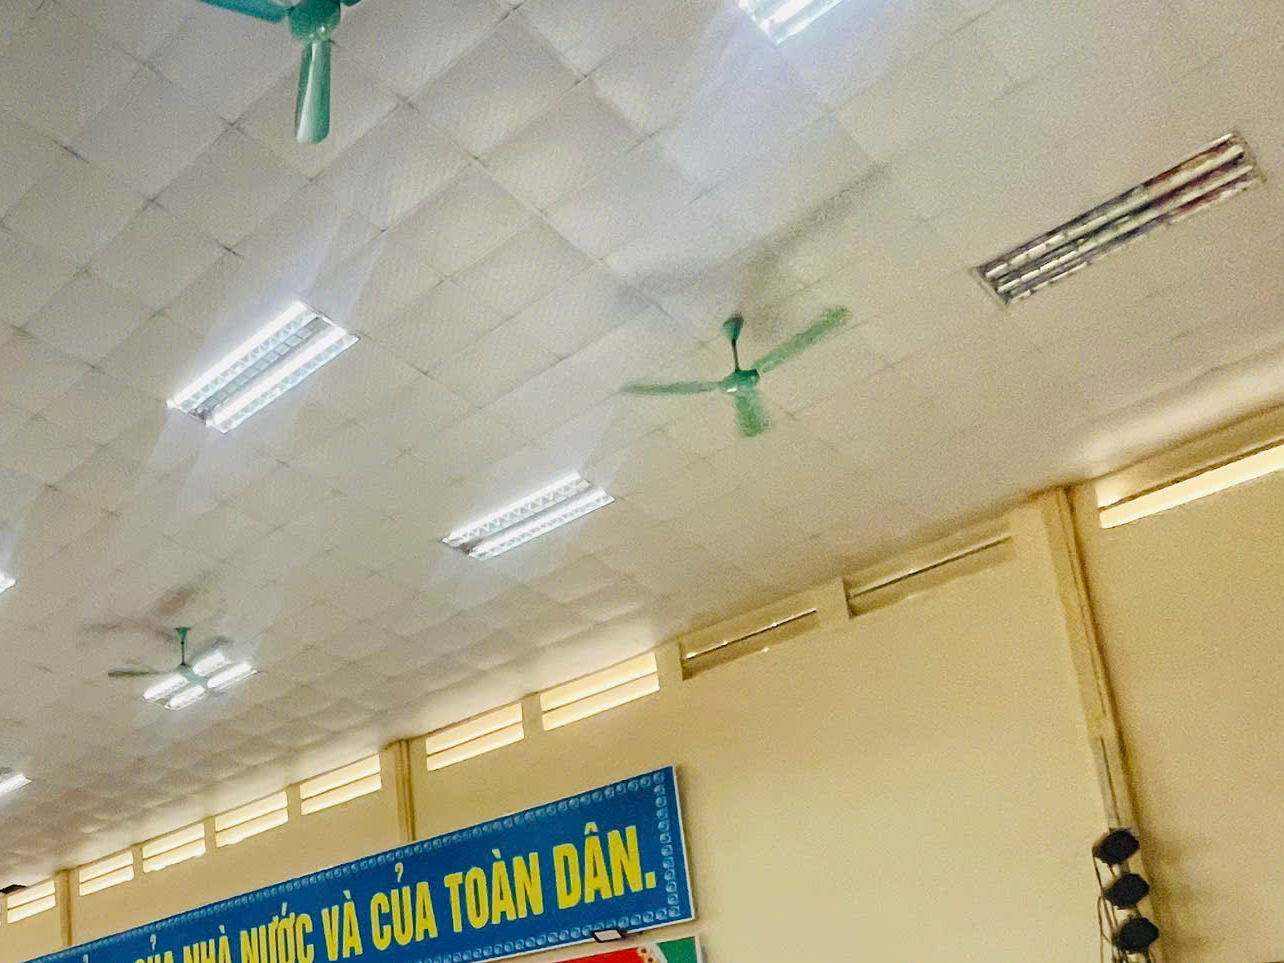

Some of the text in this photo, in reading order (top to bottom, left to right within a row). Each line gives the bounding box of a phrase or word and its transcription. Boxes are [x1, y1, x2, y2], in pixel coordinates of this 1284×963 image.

[321, 890, 363, 961] VÀ
[370, 862, 438, 951] CỦA
[444, 848, 543, 933] TOÀN
[553, 822, 656, 909] DÂN.
